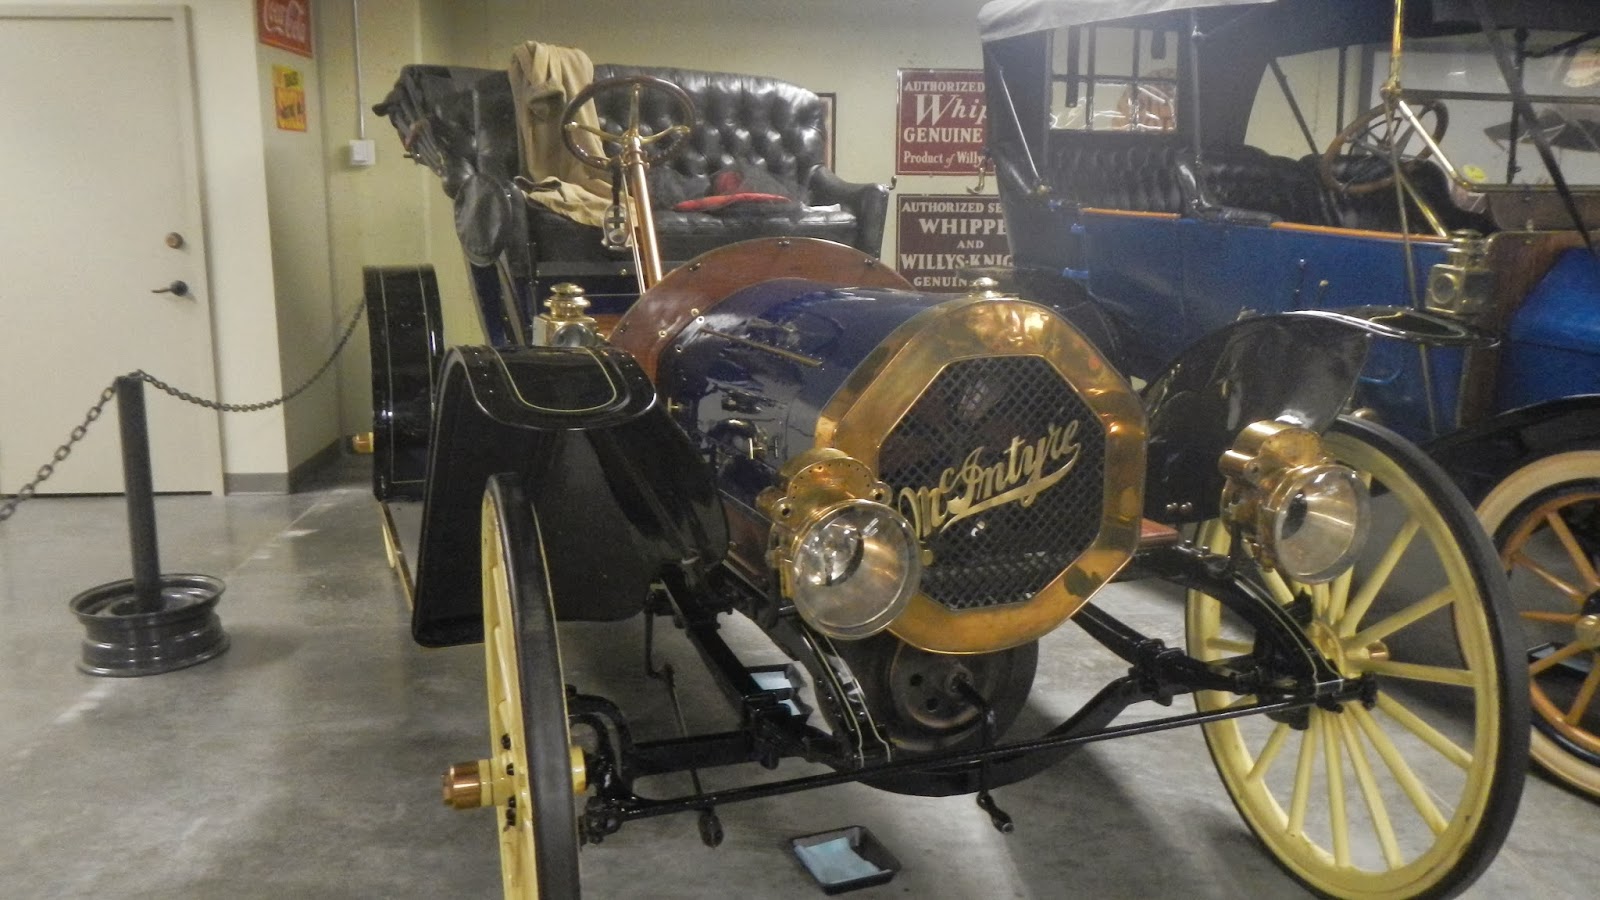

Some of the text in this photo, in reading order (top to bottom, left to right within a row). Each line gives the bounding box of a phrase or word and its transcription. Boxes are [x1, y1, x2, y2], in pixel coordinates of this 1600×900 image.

[904, 81, 986, 93] AUTHORIZED
[903, 127, 983, 143] GENUINE
[903, 150, 943, 164] Product
[944, 153, 956, 169] of
[901, 202, 985, 213] AUTHORIZED
[957, 239, 985, 249] AND
[899, 419, 1081, 540] McIntyre
